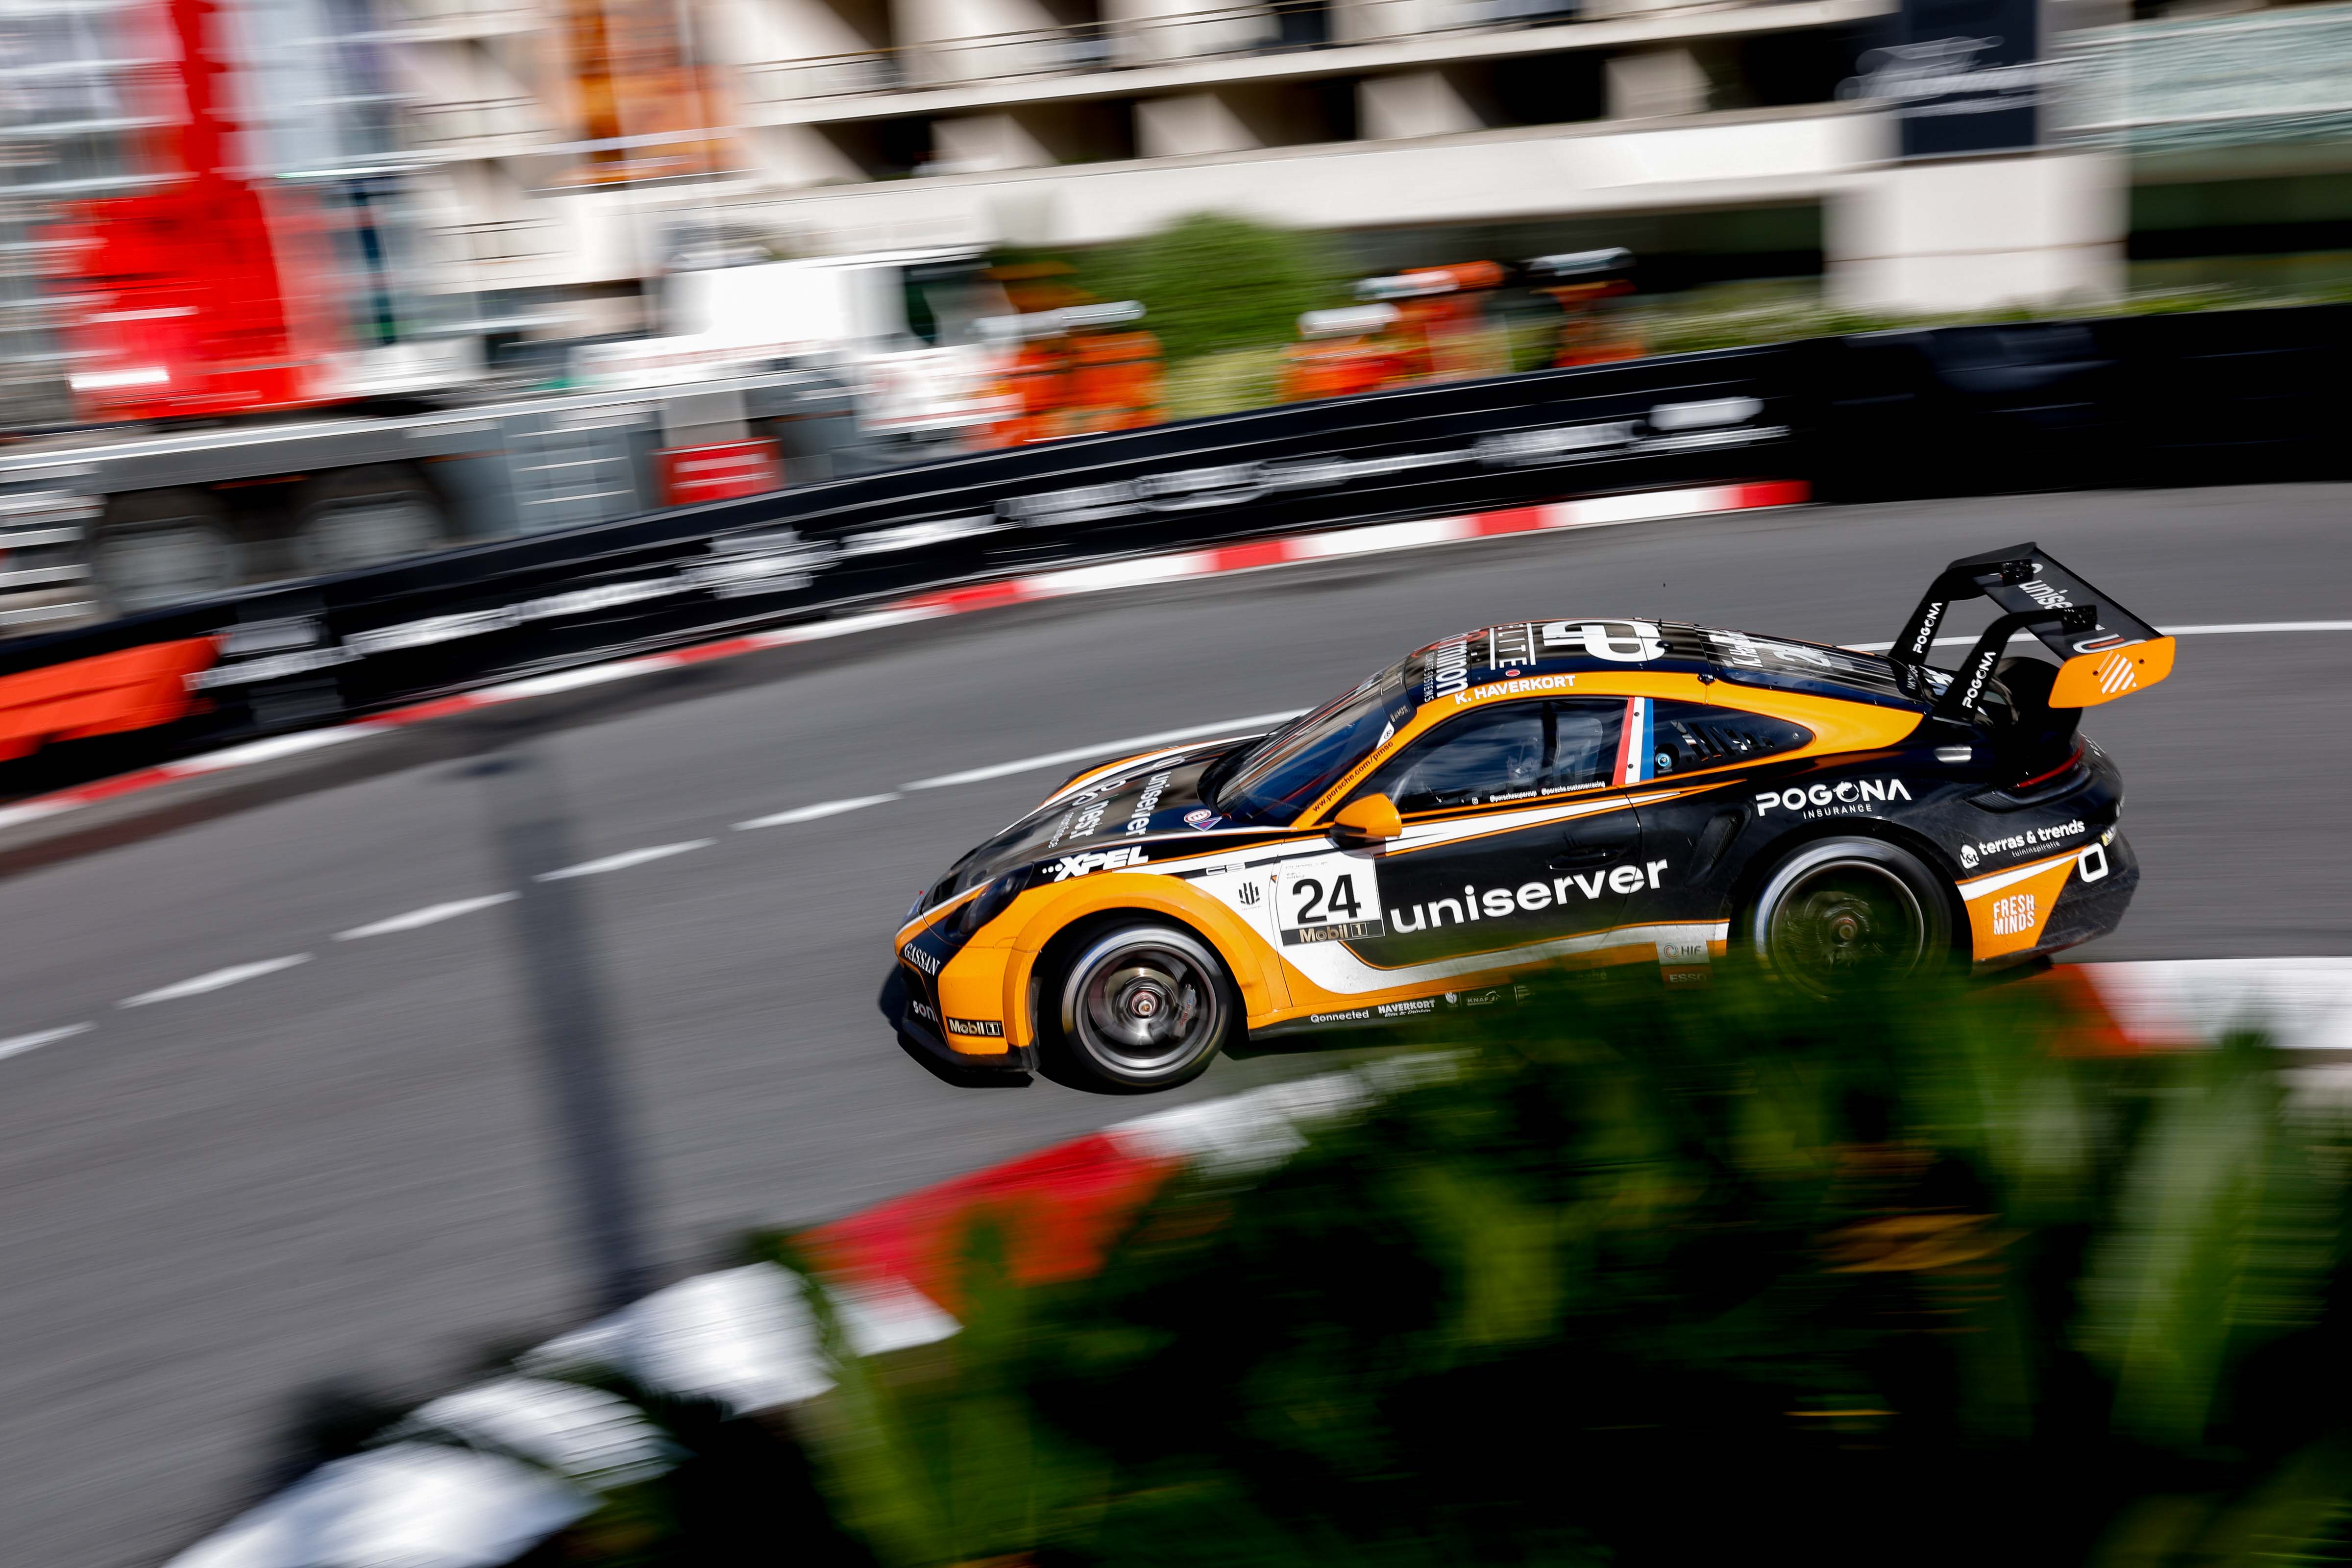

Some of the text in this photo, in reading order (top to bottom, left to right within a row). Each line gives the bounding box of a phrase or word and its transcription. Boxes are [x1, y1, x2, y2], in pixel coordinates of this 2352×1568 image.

[1497, 623, 1527, 668] ELITE
[1454, 675, 1576, 705] K. HAVERKORT
[1962, 651, 1996, 709] POGONA
[1126, 771, 1172, 836] uniserver
[1756, 779, 1912, 817] POGONA
[1803, 804, 1872, 819] INSURANCE
[1979, 834, 2025, 856] terras
[2027, 830, 2037, 844] &
[2037, 819, 2085, 842] trends
[2011, 840, 2061, 858] tuininspiratie
[1054, 845, 1149, 882] XPEL
[1293, 874, 1361, 925] 24
[1390, 859, 1668, 933] uniserver
[1993, 893, 2035, 920] FRESH
[1299, 924, 1348, 943] Mobil
[1993, 911, 2035, 935] MINDS
[904, 942, 941, 976] GASSAN
[1681, 945, 1701, 956] HIF
[1310, 1009, 1370, 1023] Qonnected
[1377, 999, 1435, 1014] HAVERKORT
[949, 1019, 985, 1035] Mobil
